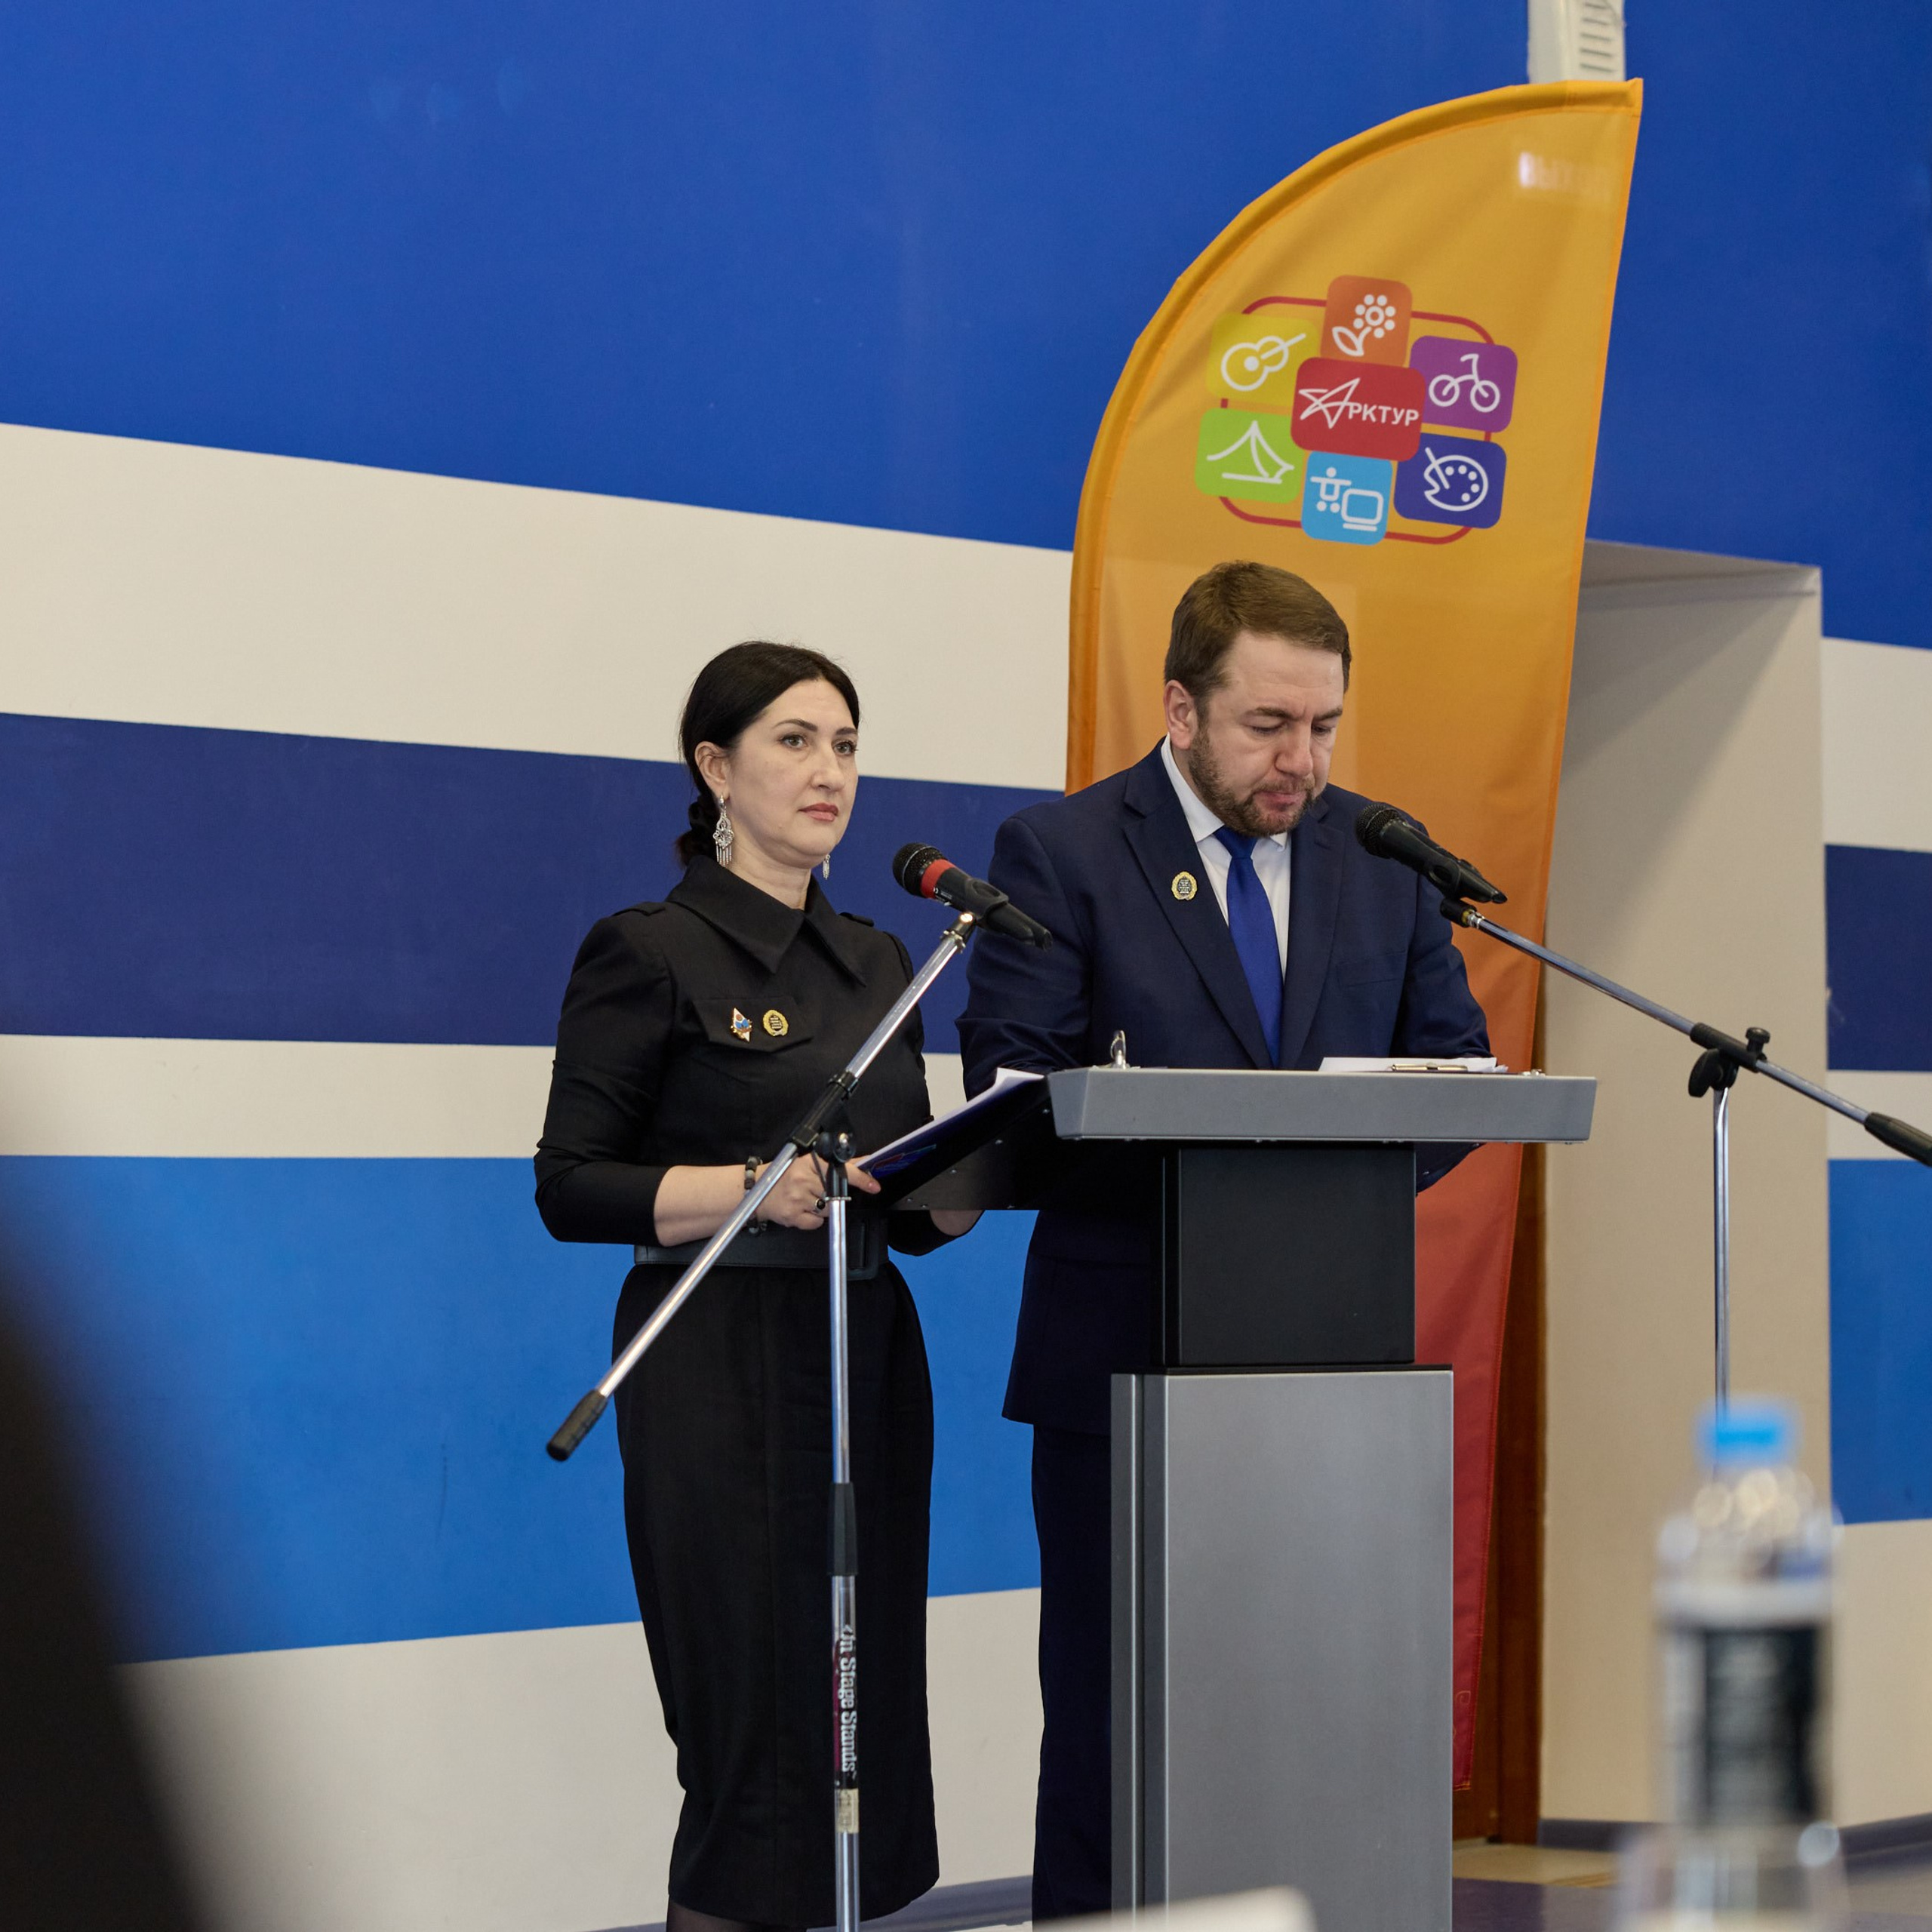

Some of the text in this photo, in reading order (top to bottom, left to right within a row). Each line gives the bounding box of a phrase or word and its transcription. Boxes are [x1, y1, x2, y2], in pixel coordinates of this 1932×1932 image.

[1298, 377, 1420, 429] АРКТУР
[838, 1657, 857, 1709] Stage
[841, 1711, 857, 1772] Stands
